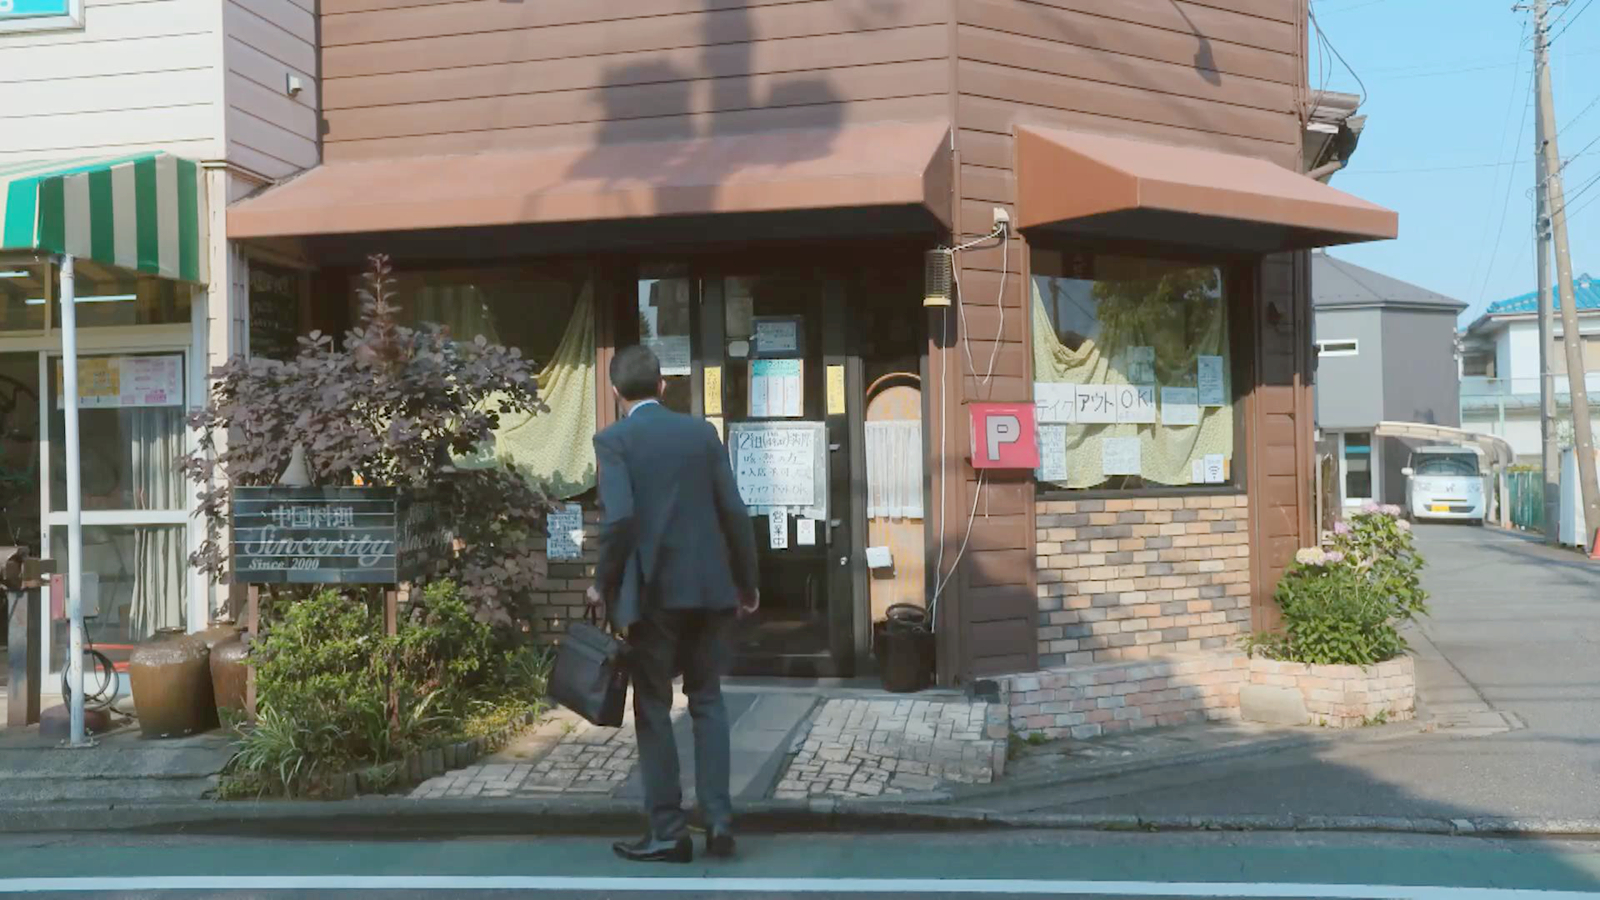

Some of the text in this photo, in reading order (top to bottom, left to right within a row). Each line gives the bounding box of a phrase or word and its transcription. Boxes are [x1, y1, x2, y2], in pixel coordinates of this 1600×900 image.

[985, 414, 1021, 461] P
[272, 505, 354, 528] 中国料理
[246, 524, 390, 567] Sincerity
[249, 558, 320, 570] Since 2000
